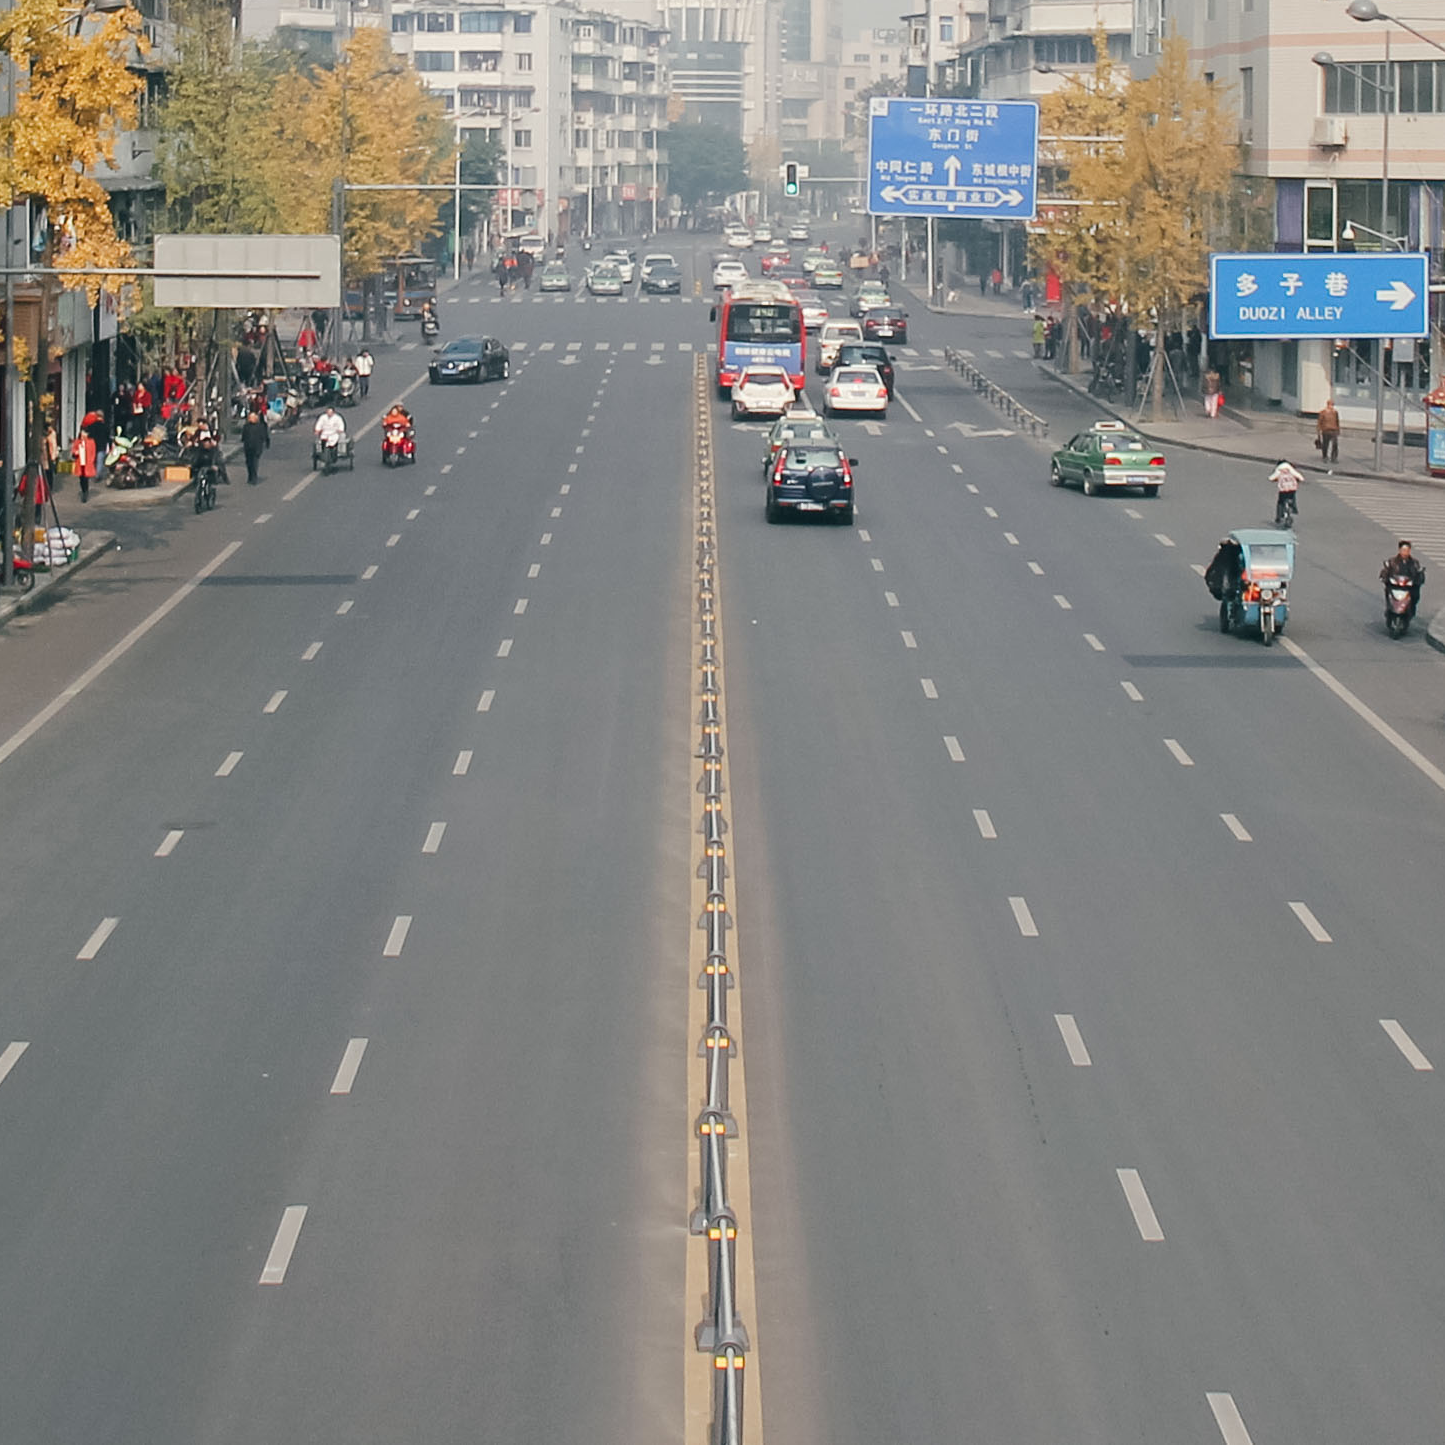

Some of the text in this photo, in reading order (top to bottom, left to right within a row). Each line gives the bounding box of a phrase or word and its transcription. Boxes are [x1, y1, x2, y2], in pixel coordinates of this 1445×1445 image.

[909, 103, 999, 119] 一环路北二段
[1236, 272, 1349, 297] 多子巷
[1239, 306, 1343, 320] DUOZI ALLEY
